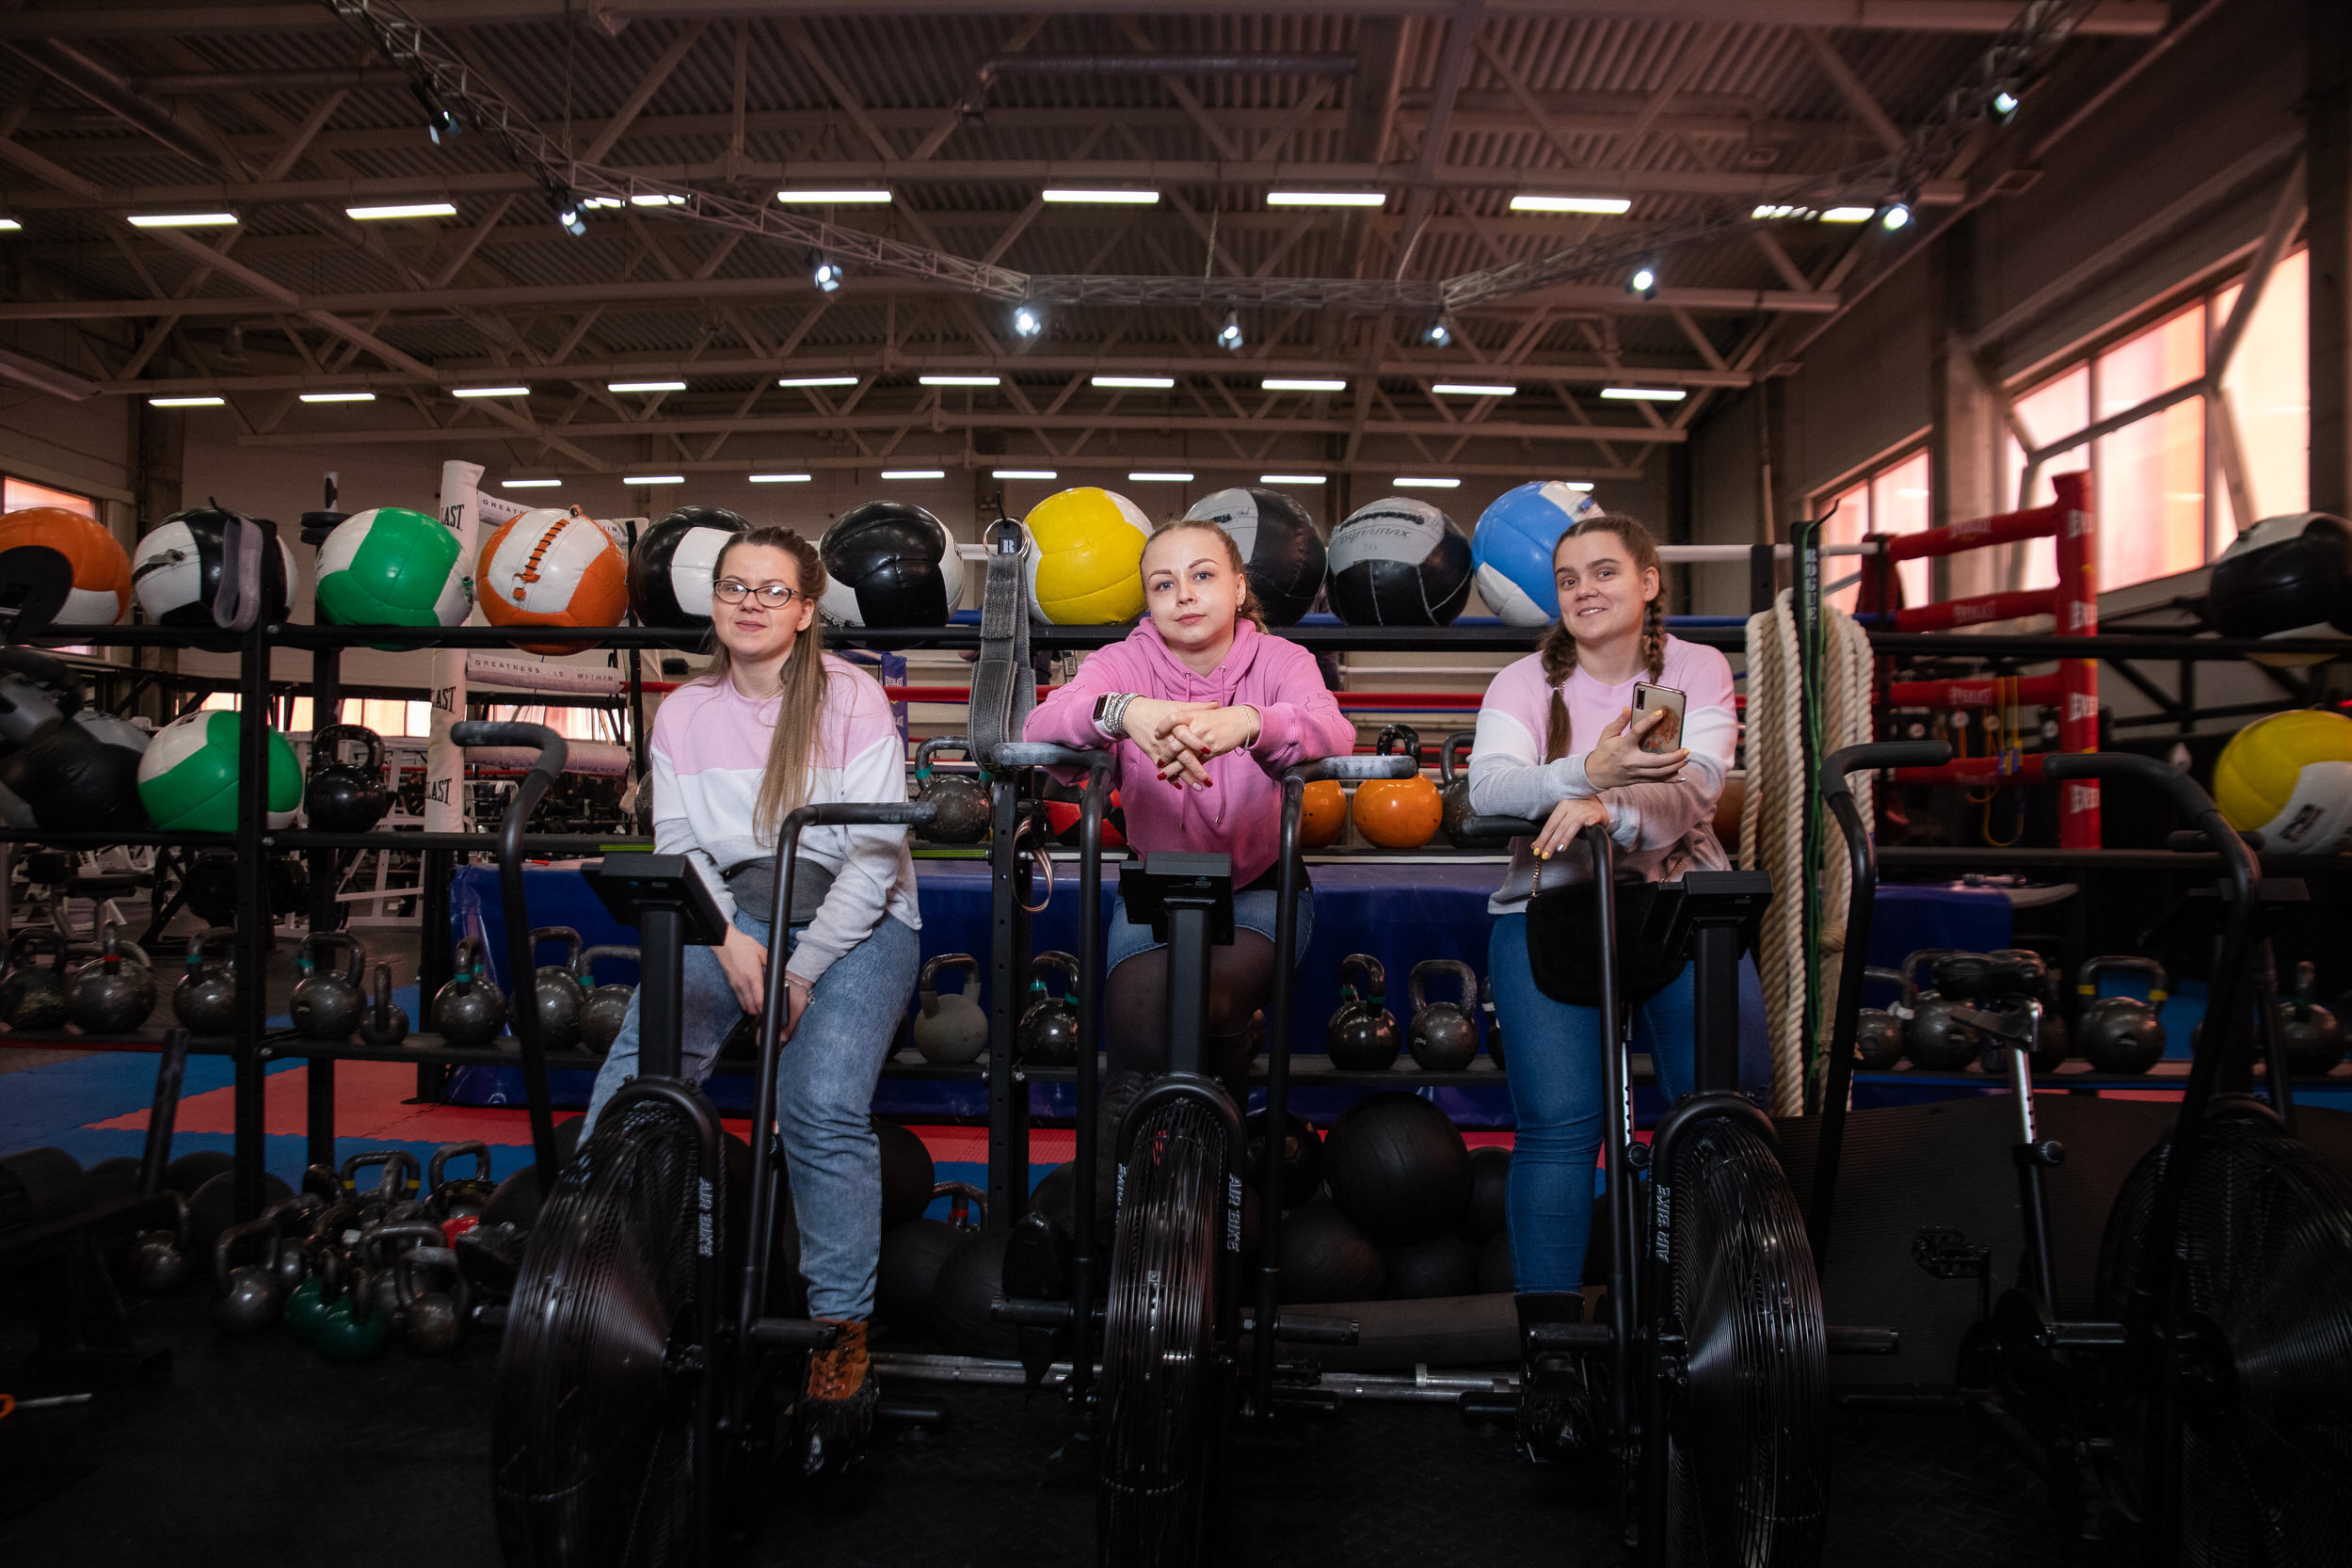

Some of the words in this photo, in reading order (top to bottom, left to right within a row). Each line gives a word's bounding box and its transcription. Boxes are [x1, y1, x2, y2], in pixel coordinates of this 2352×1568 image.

[482, 499, 523, 514] GREAT
[1002, 539, 1016, 553] R
[474, 659, 540, 674] GREATNESS
[577, 673, 614, 682] WITHIN
[699, 1176, 713, 1210] AIR
[1228, 1173, 1242, 1207] AIR
[1656, 1184, 1671, 1227] BIKE
[699, 1212, 713, 1257] BIKE
[1227, 1208, 1242, 1253] BIKE
[1656, 1230, 1670, 1264] AIR
